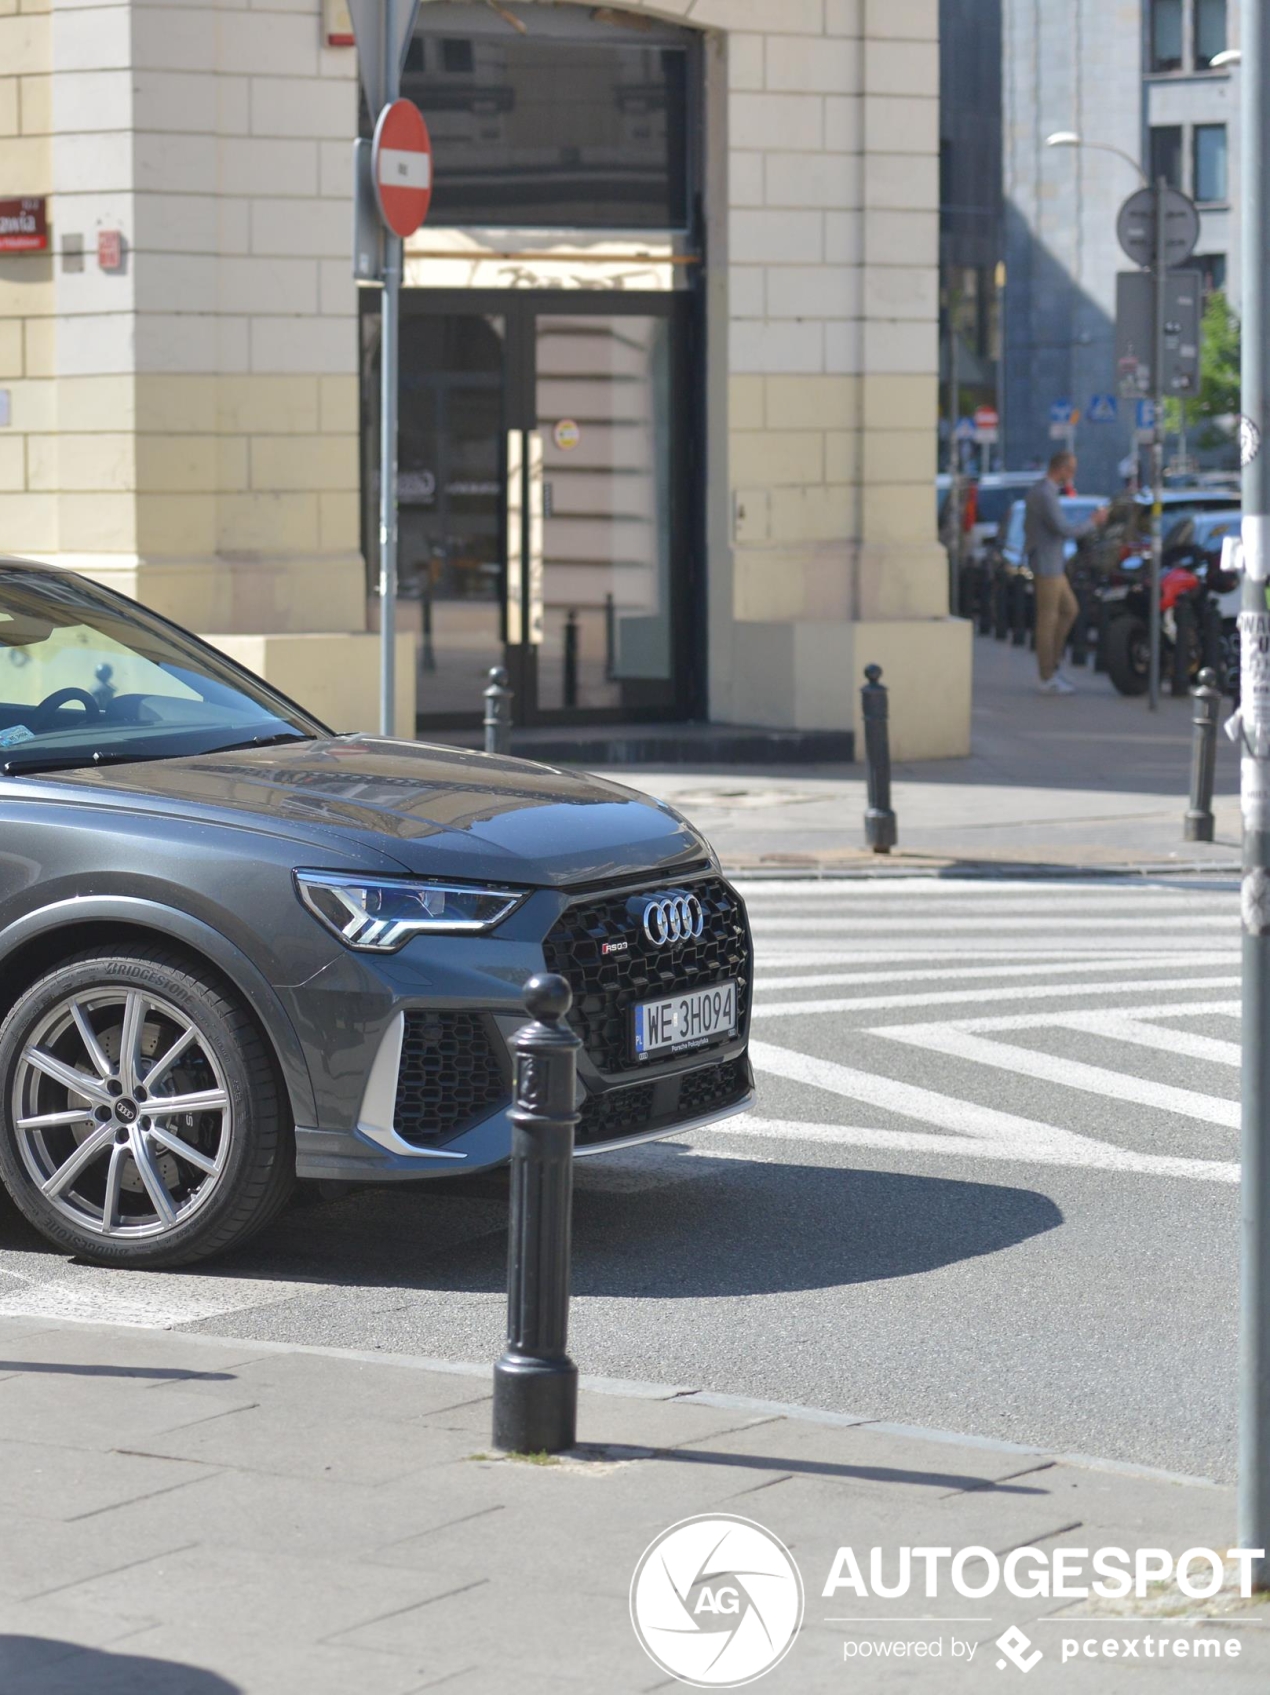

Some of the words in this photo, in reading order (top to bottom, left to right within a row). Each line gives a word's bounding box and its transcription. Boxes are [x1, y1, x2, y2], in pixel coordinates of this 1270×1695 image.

[605, 941, 628, 954] RSQ3
[104, 961, 196, 1006] BRIDGESTONE
[648, 1003, 672, 1046] WE
[679, 988, 732, 1038] 3H094
[636, 1035, 643, 1047] PL
[42, 1217, 130, 1258] BRIDGESTONE
